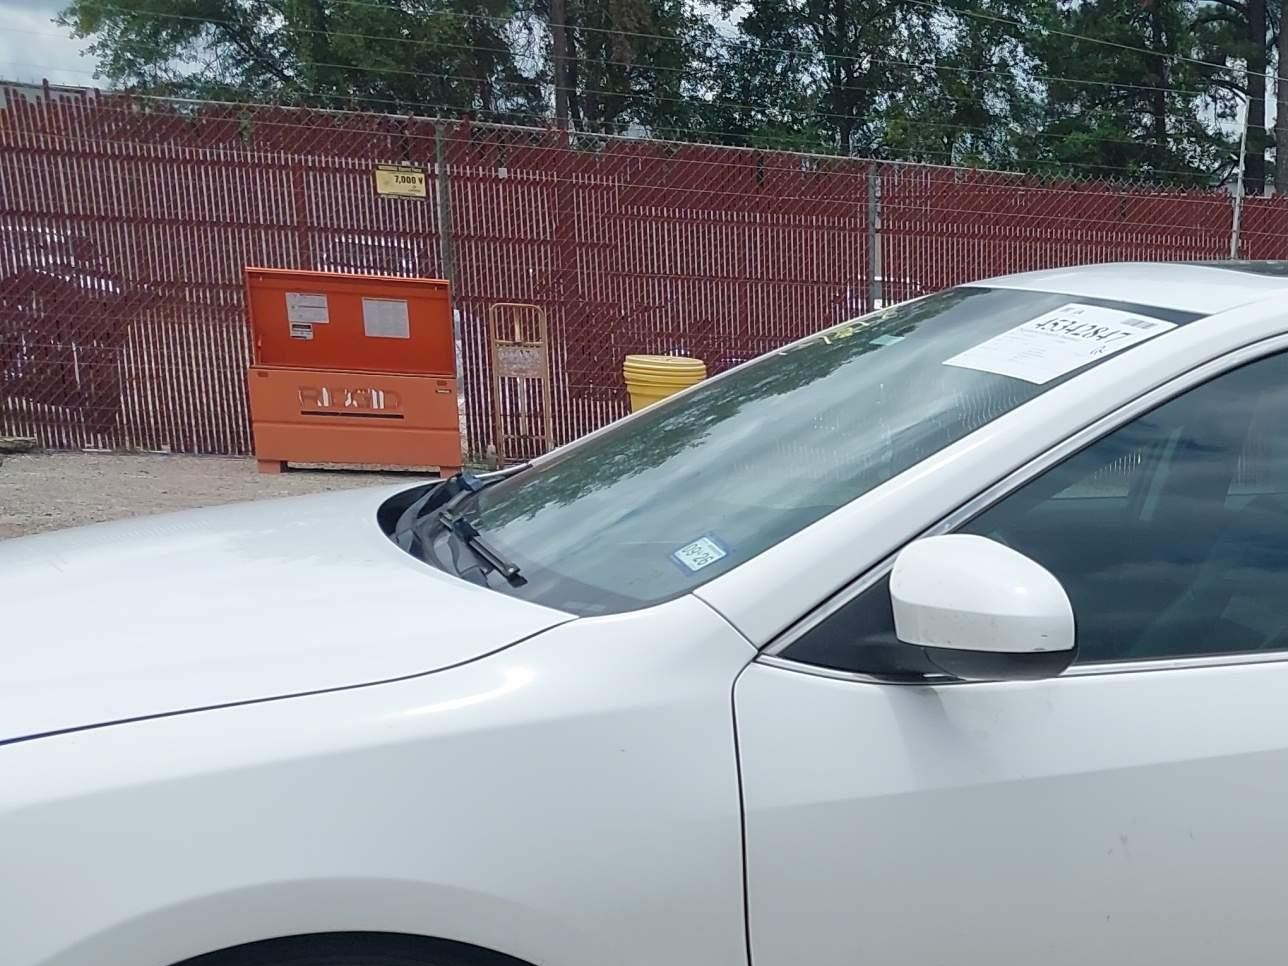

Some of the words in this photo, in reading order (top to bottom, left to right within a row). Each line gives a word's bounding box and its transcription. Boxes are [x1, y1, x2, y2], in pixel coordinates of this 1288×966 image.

[394, 175, 416, 185] 7,000
[418, 176, 424, 185] V
[1035, 316, 1132, 344] 45342847
